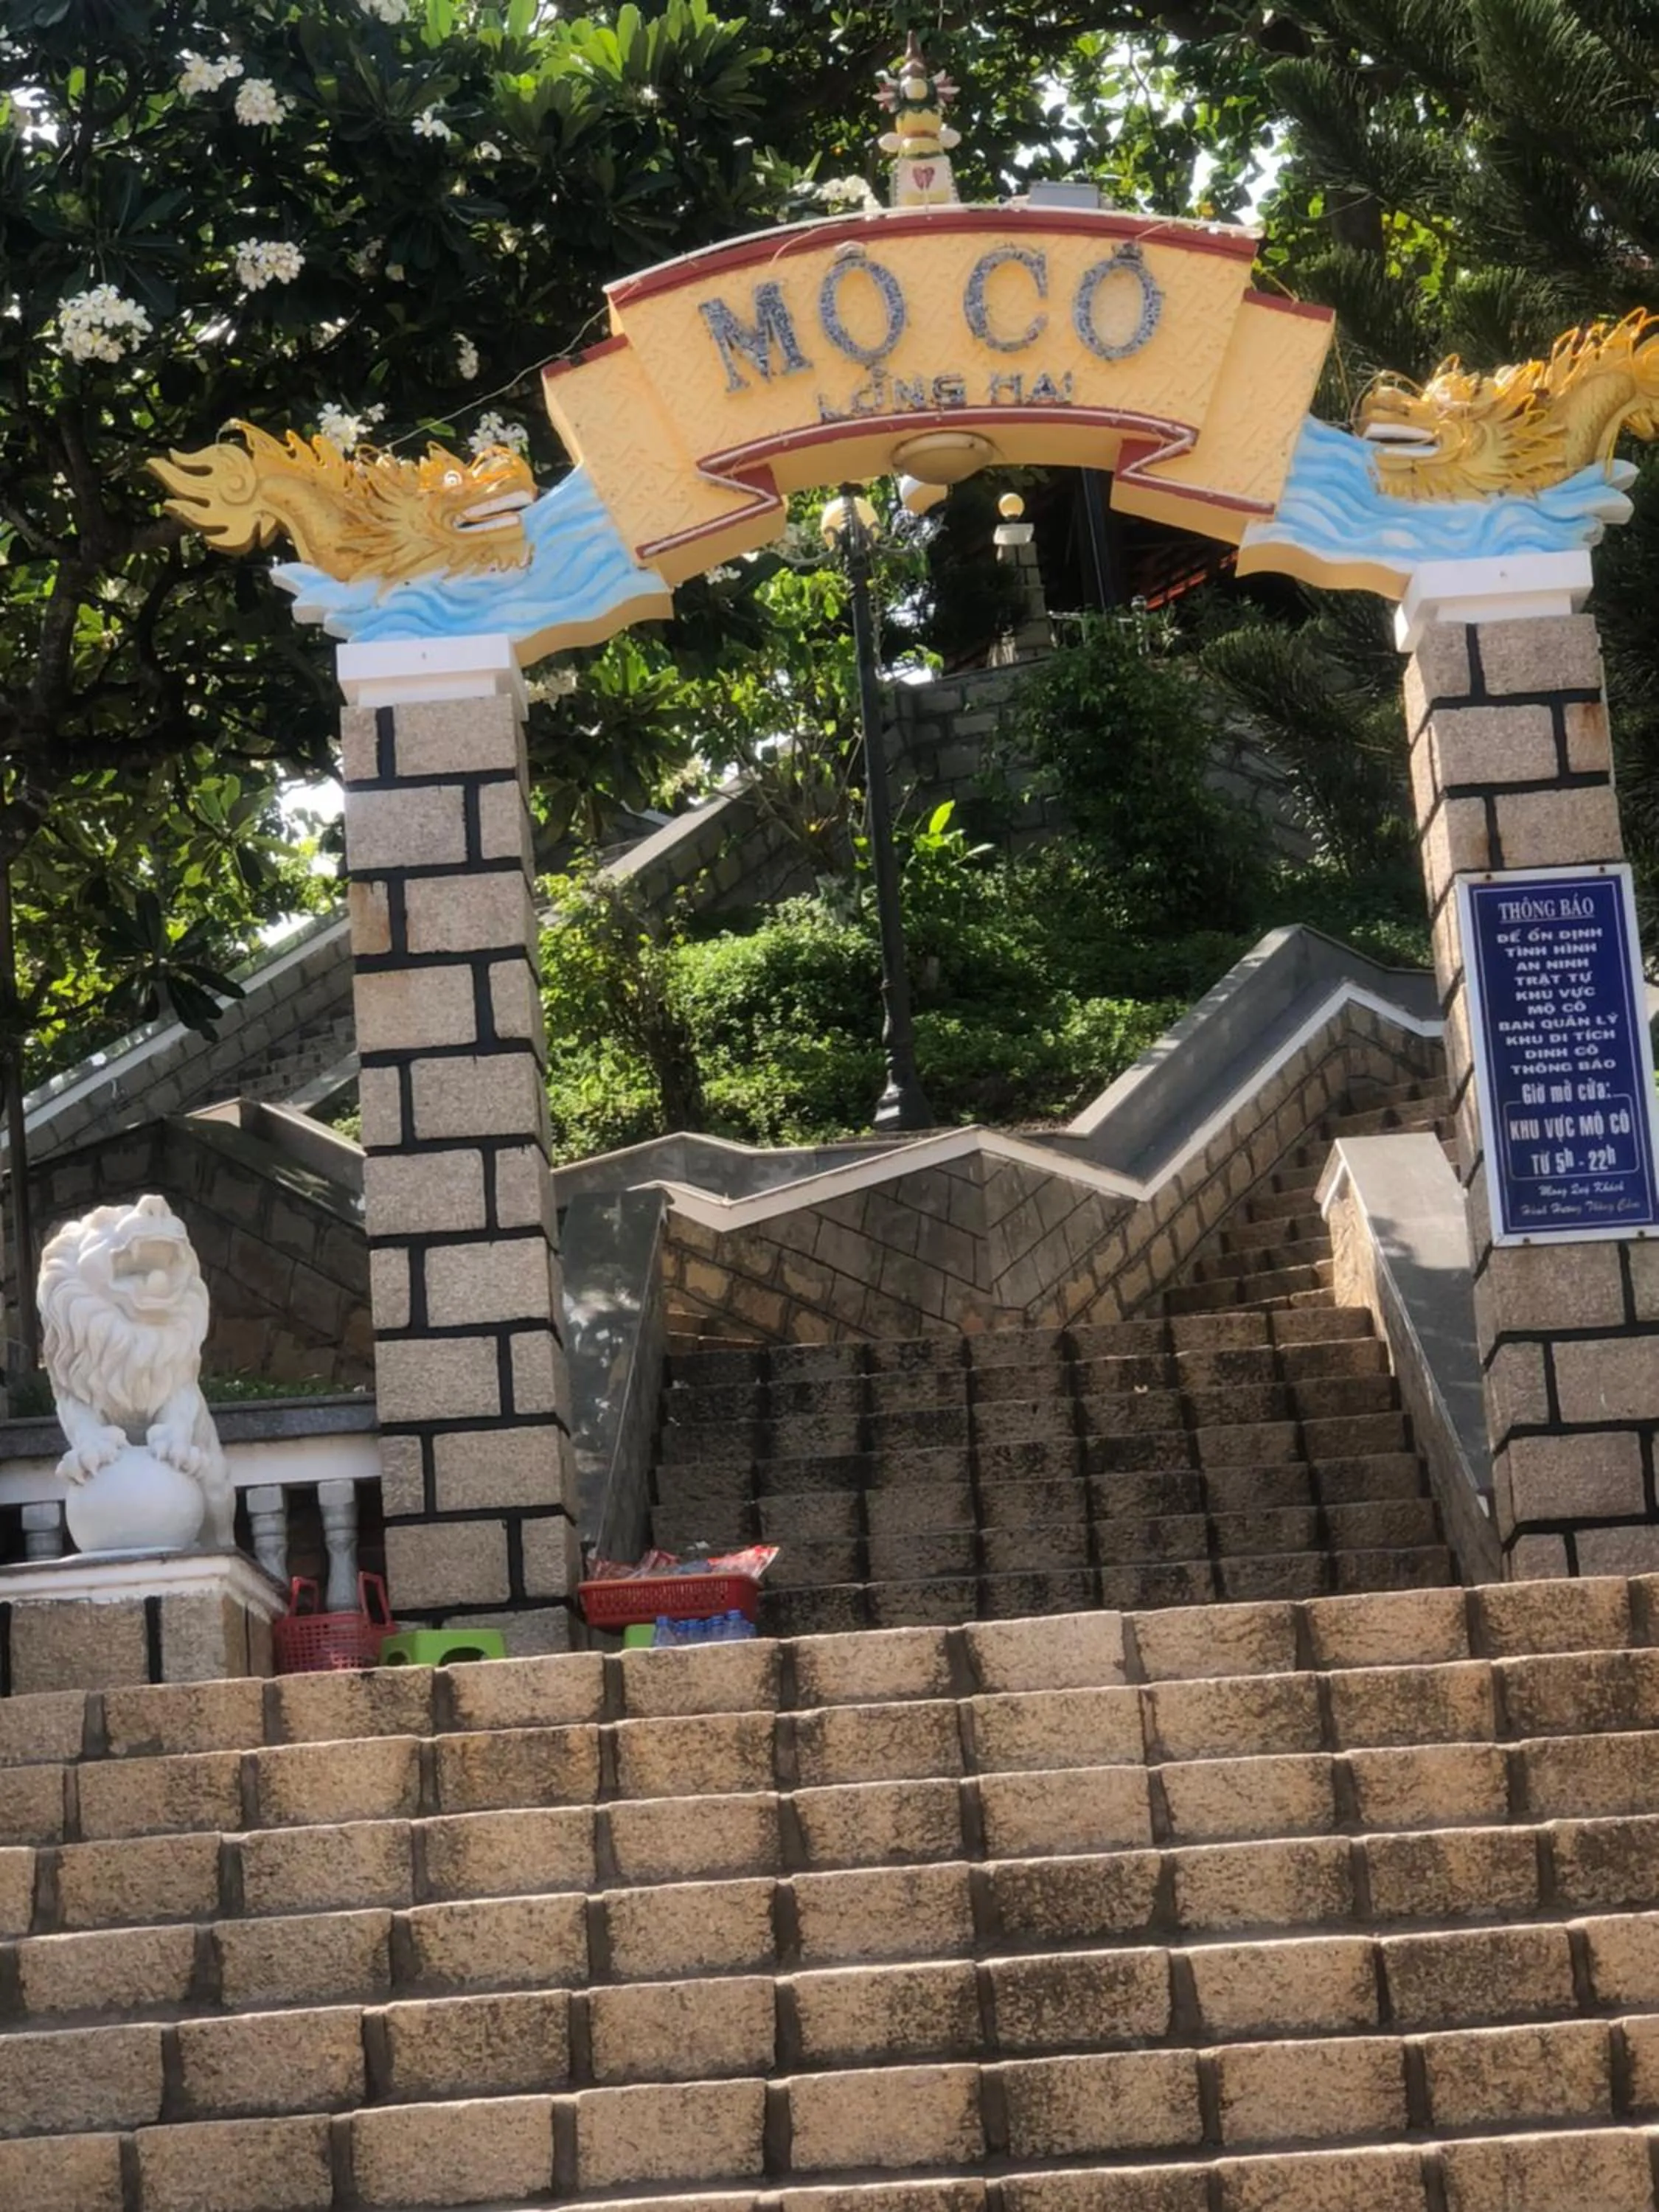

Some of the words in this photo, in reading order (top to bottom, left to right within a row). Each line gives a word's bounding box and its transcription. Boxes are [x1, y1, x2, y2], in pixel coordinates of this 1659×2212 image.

[1498, 897, 1555, 922] THÔNG
[1559, 893, 1594, 917] BÁO
[1504, 945, 1547, 958] TÌNH
[1554, 942, 1597, 955] HÌNH
[1516, 961, 1540, 972] AN
[1545, 958, 1590, 970] NINH
[1514, 973, 1562, 987] TRẬT
[1568, 970, 1593, 984] TỰ
[1515, 990, 1554, 1001] KHU
[1559, 987, 1597, 999] VỰC
[1562, 1001, 1587, 1013] CÔ
[1498, 1020, 1535, 1032] BAN
[1540, 1015, 1590, 1030] QUẢN
[1506, 1035, 1543, 1046] KHU
[1549, 1032, 1568, 1043] DI
[1573, 1030, 1616, 1041] TÍCH
[1525, 1047, 1568, 1060] DINH
[1573, 1044, 1599, 1057] CÔ
[1511, 1062, 1573, 1075] THÔNG
[1579, 1059, 1617, 1071] BÁO
[1522, 1082, 1546, 1105] Giờ
[1550, 1079, 1573, 1103] mở
[1578, 1077, 1611, 1101] cửa:
[1509, 1119, 1540, 1141] KHU
[1544, 1114, 1576, 1143] VỰC
[1579, 1110, 1604, 1141] MỘ
[1610, 1109, 1630, 1134] CÔ
[1555, 1147, 1574, 1174] 5h
[1588, 1144, 1616, 1172] 22h
